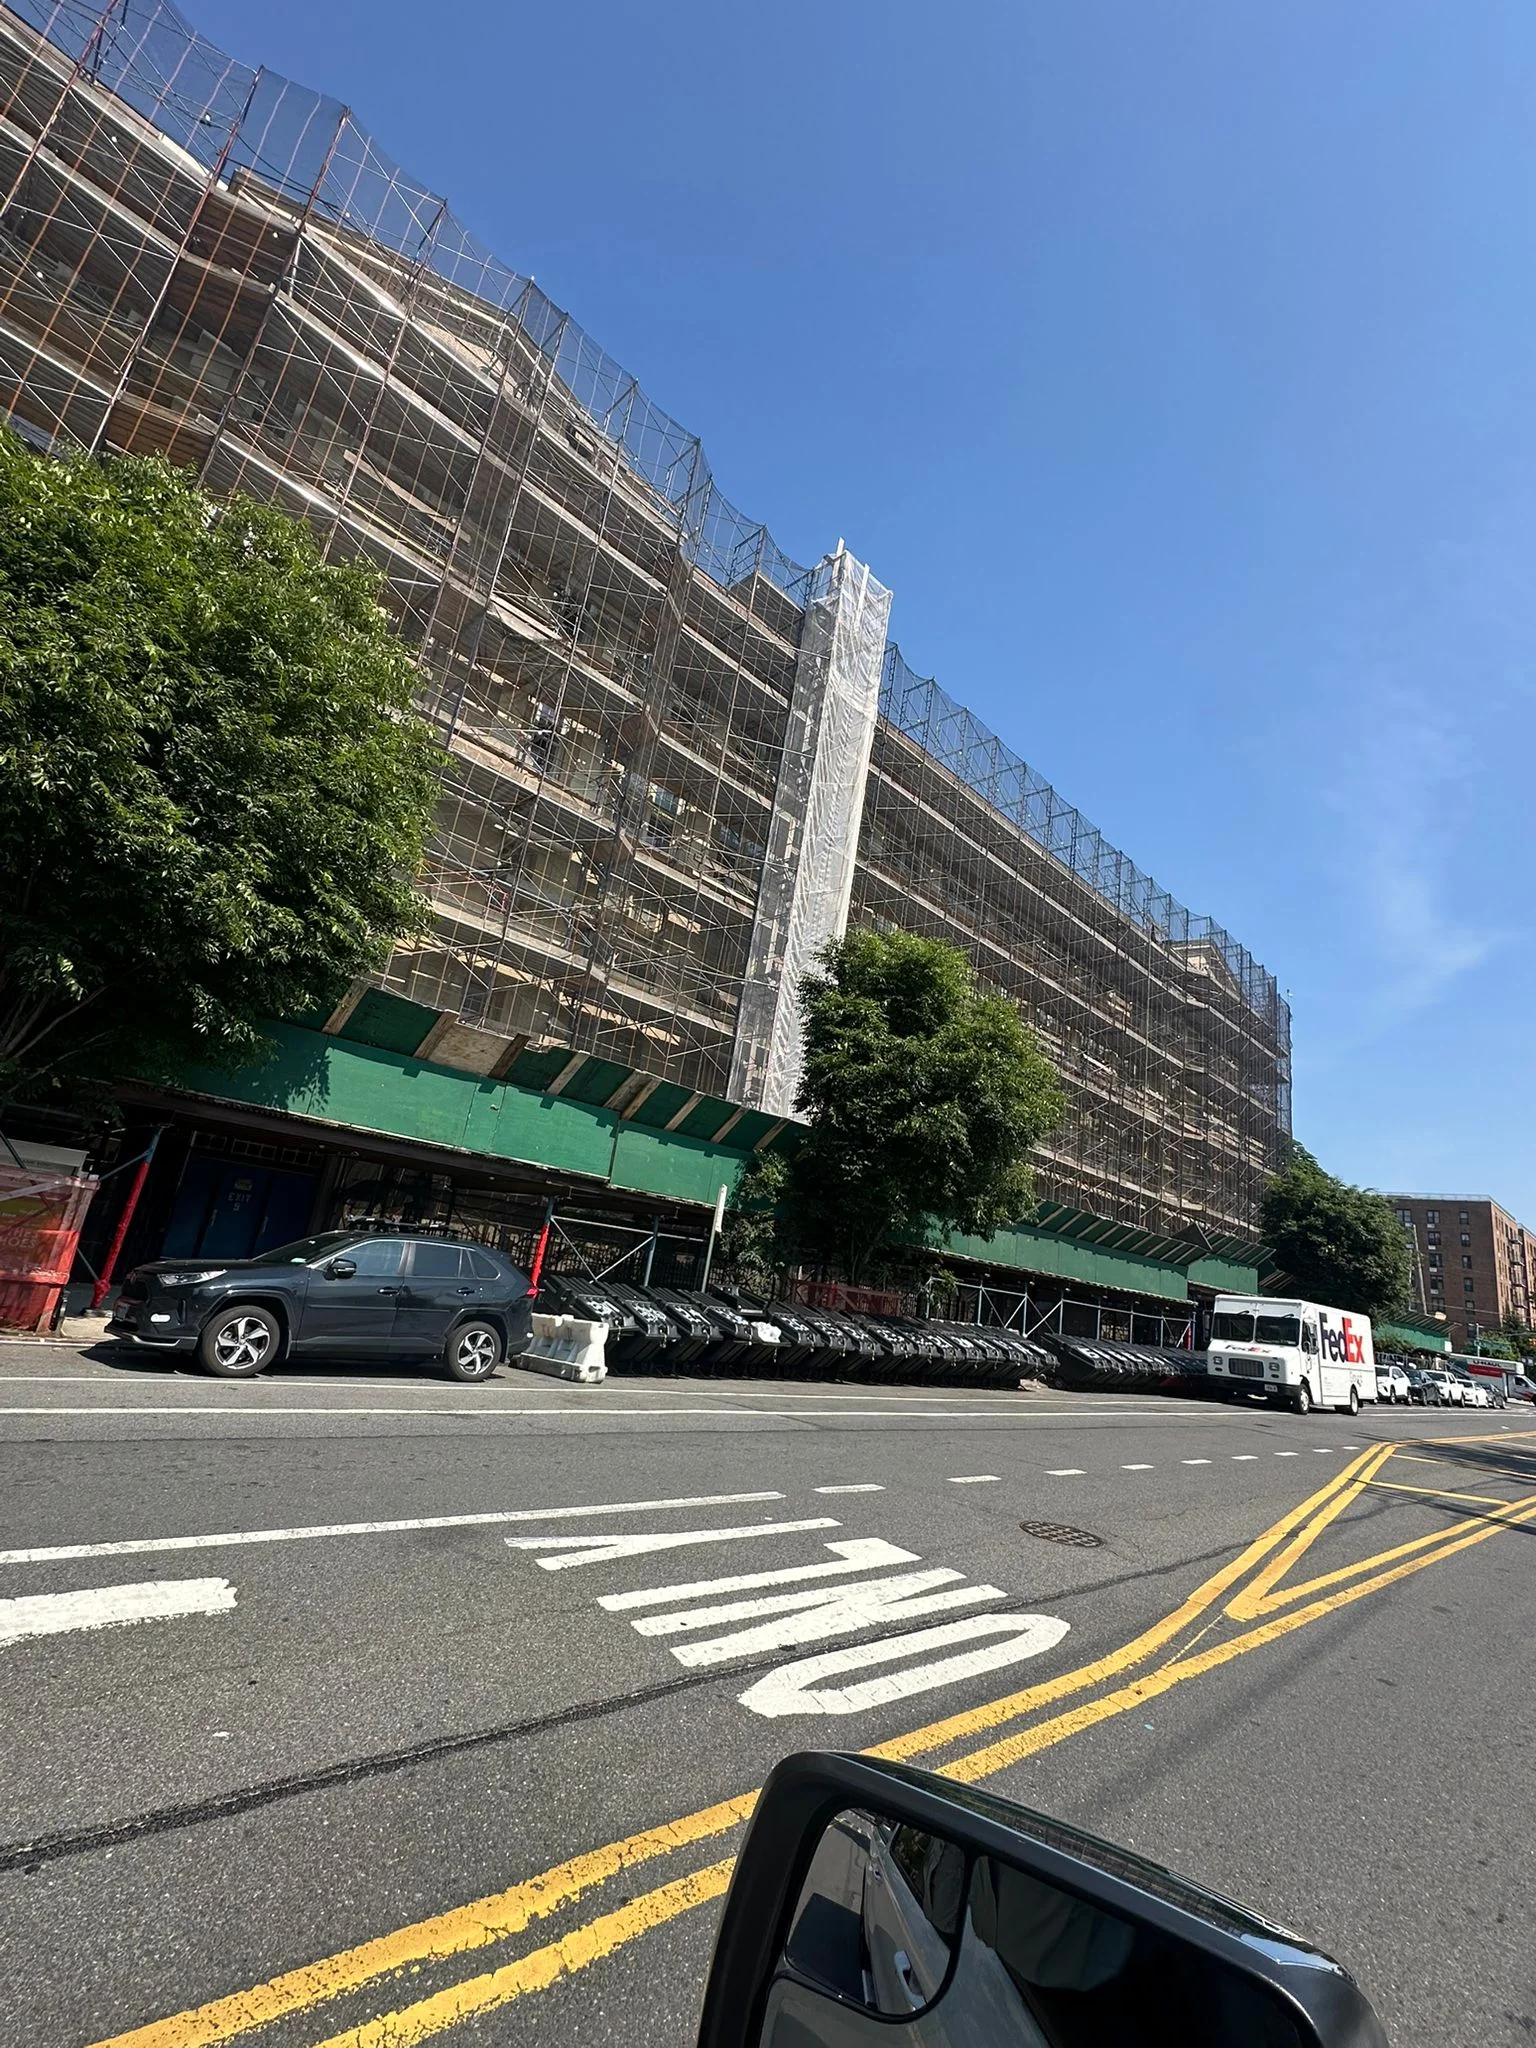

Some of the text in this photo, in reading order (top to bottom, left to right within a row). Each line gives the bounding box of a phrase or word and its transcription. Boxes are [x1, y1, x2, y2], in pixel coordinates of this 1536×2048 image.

[228, 1192, 252, 1203] EXIT
[1319, 1312, 1365, 1364] FedEx
[503, 1517, 1071, 1718] ONLY
